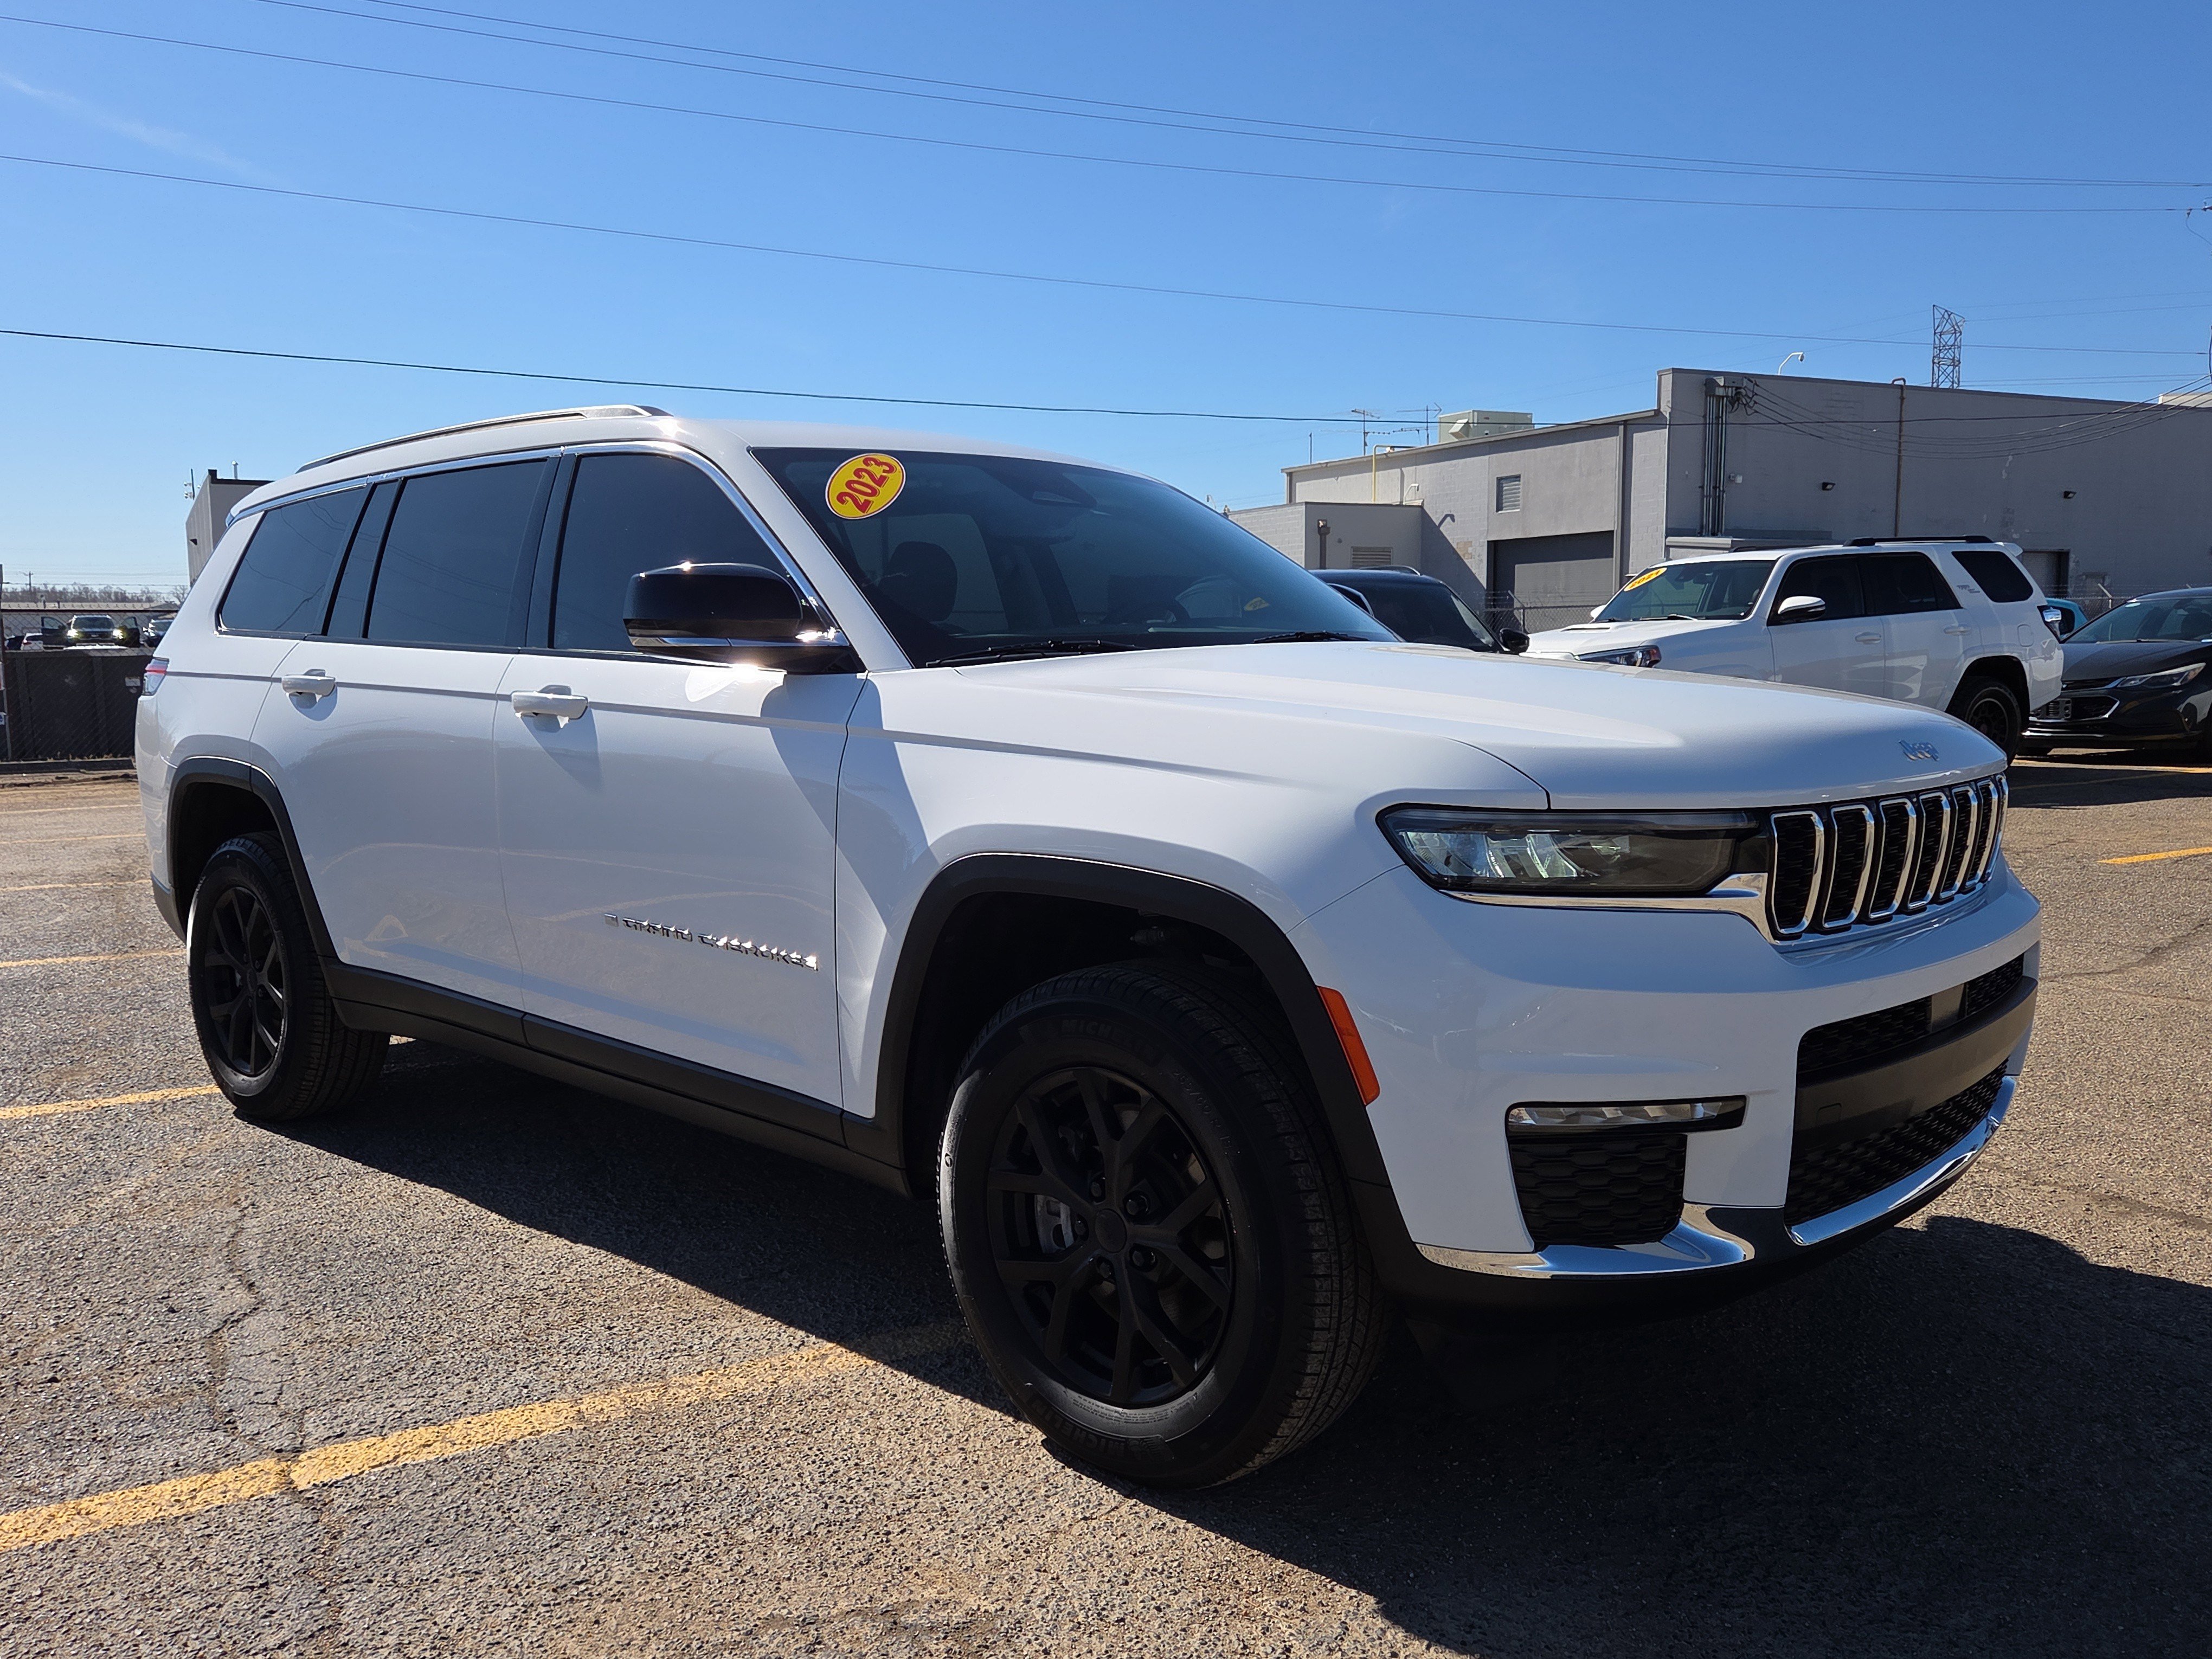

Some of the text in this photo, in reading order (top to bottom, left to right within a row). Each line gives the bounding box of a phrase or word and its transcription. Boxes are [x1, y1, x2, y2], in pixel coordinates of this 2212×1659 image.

[837, 457, 896, 513] 2023
[1629, 570, 1660, 589] 2021
[1899, 740, 1939, 761] Jeep
[622, 916, 818, 971] GRAND CHEROKEE
[1031, 1400, 1126, 1457] MICHELIN
